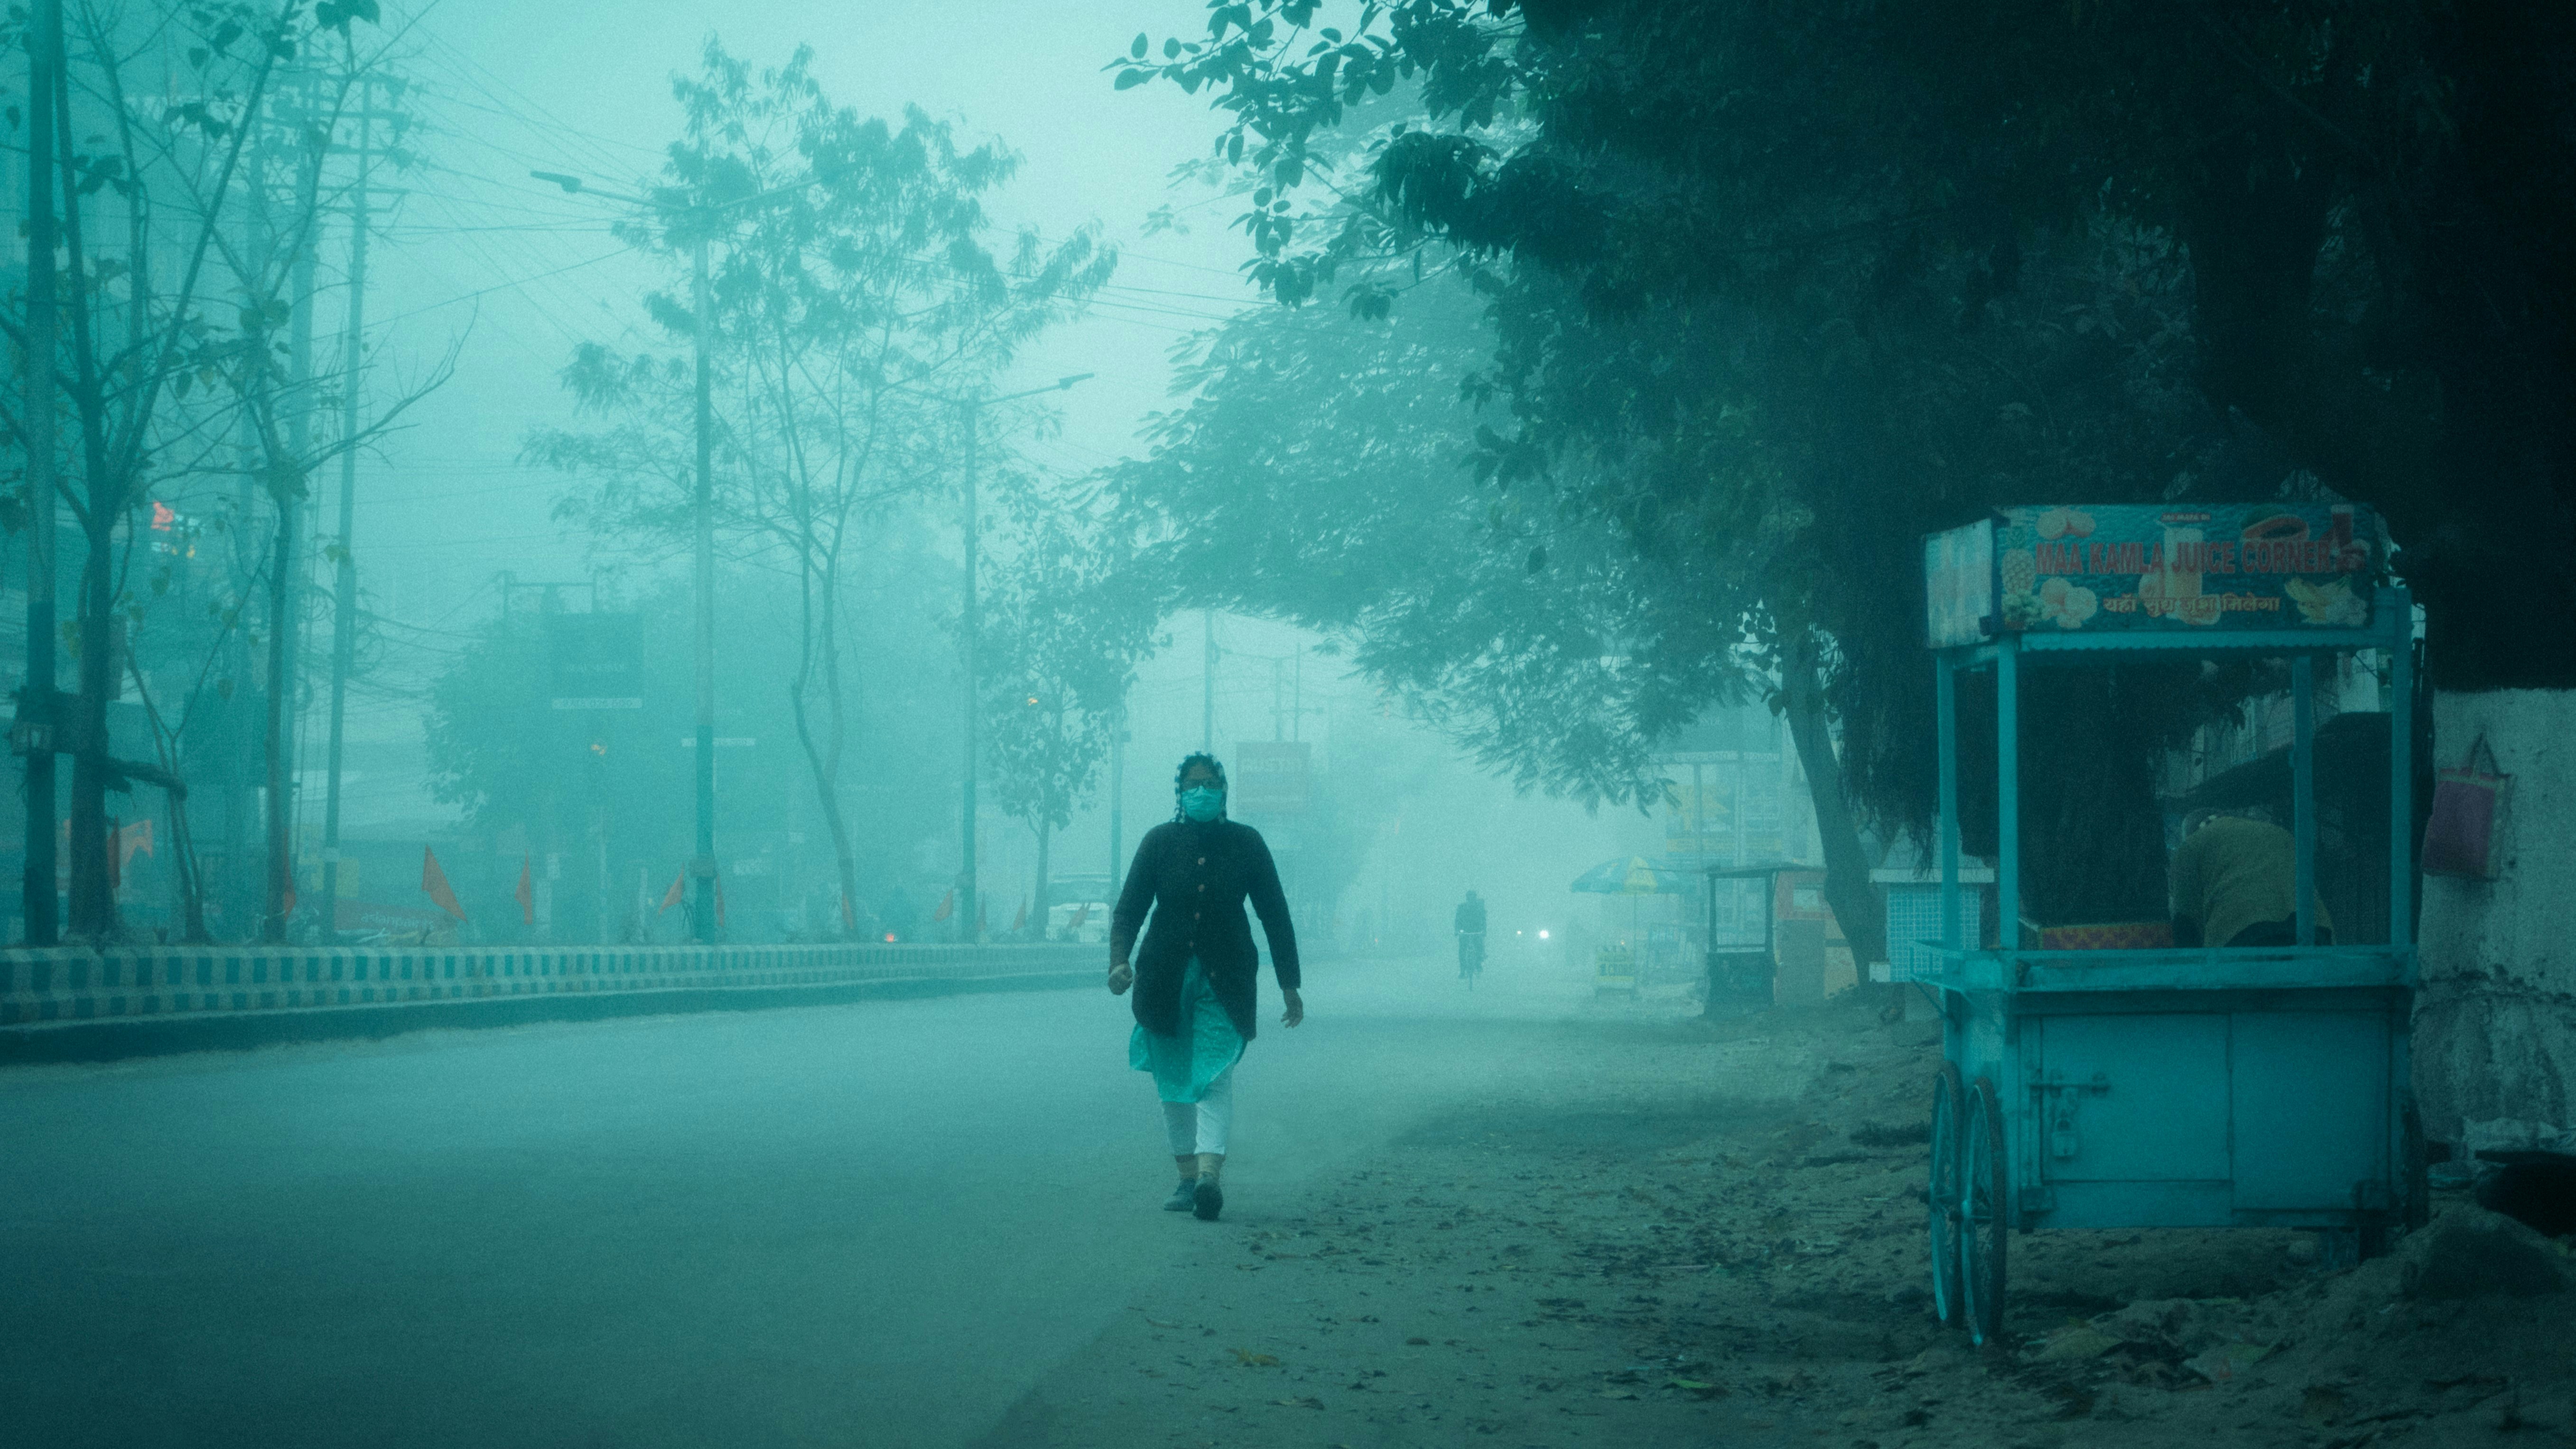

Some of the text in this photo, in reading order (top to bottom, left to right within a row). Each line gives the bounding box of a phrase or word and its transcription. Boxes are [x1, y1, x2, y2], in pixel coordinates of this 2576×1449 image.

[2036, 541, 2331, 574] MAA KAMLA JUICE CORNER
[2220, 591, 2281, 612] मिलेगा
